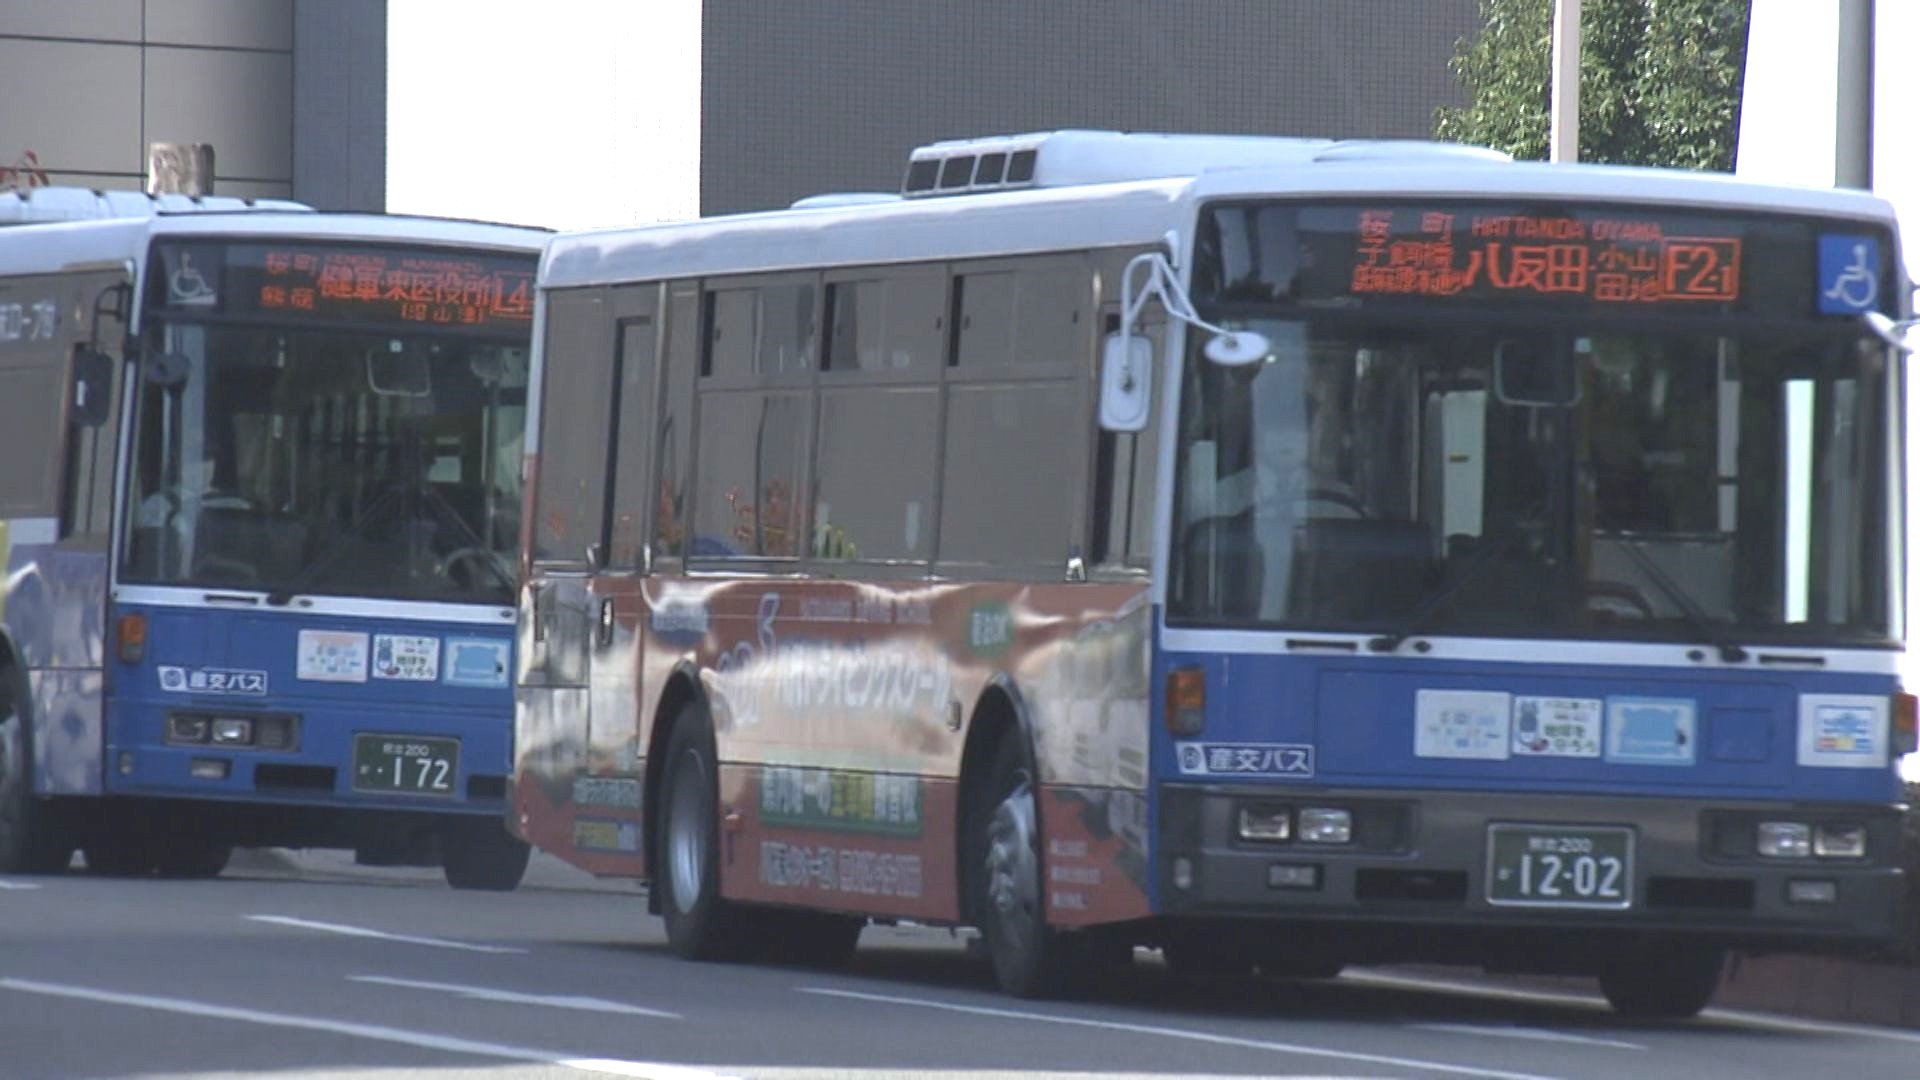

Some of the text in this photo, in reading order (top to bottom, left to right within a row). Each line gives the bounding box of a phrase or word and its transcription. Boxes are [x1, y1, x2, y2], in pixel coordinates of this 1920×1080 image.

[1592, 219, 1662, 241] OYAMA
[1666, 245, 1732, 294] F2-1
[1208, 746, 1310, 773] 産交バス
[1519, 853, 1623, 897] 12-02
